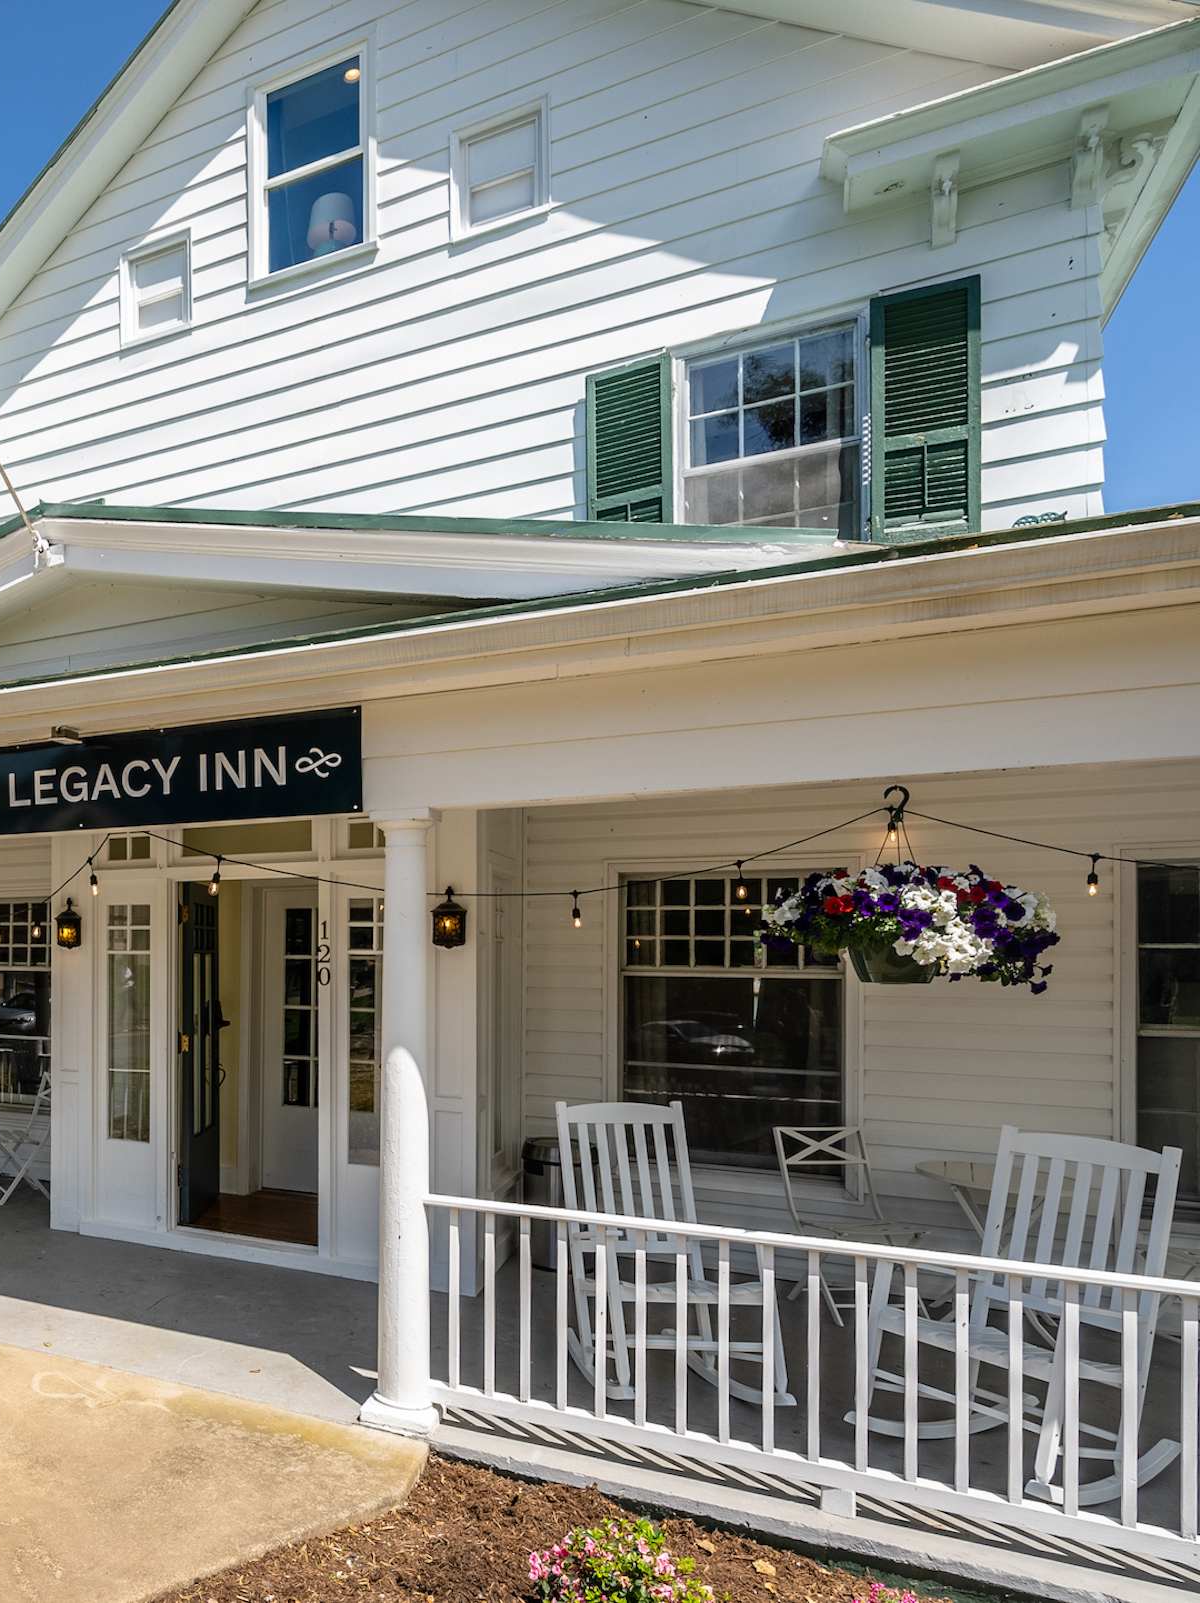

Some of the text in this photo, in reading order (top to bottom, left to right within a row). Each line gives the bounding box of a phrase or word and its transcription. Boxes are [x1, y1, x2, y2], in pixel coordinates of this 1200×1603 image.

[8, 756, 182, 808] LEGACY
[199, 745, 287, 793] INN
[316, 920, 331, 986] 120
